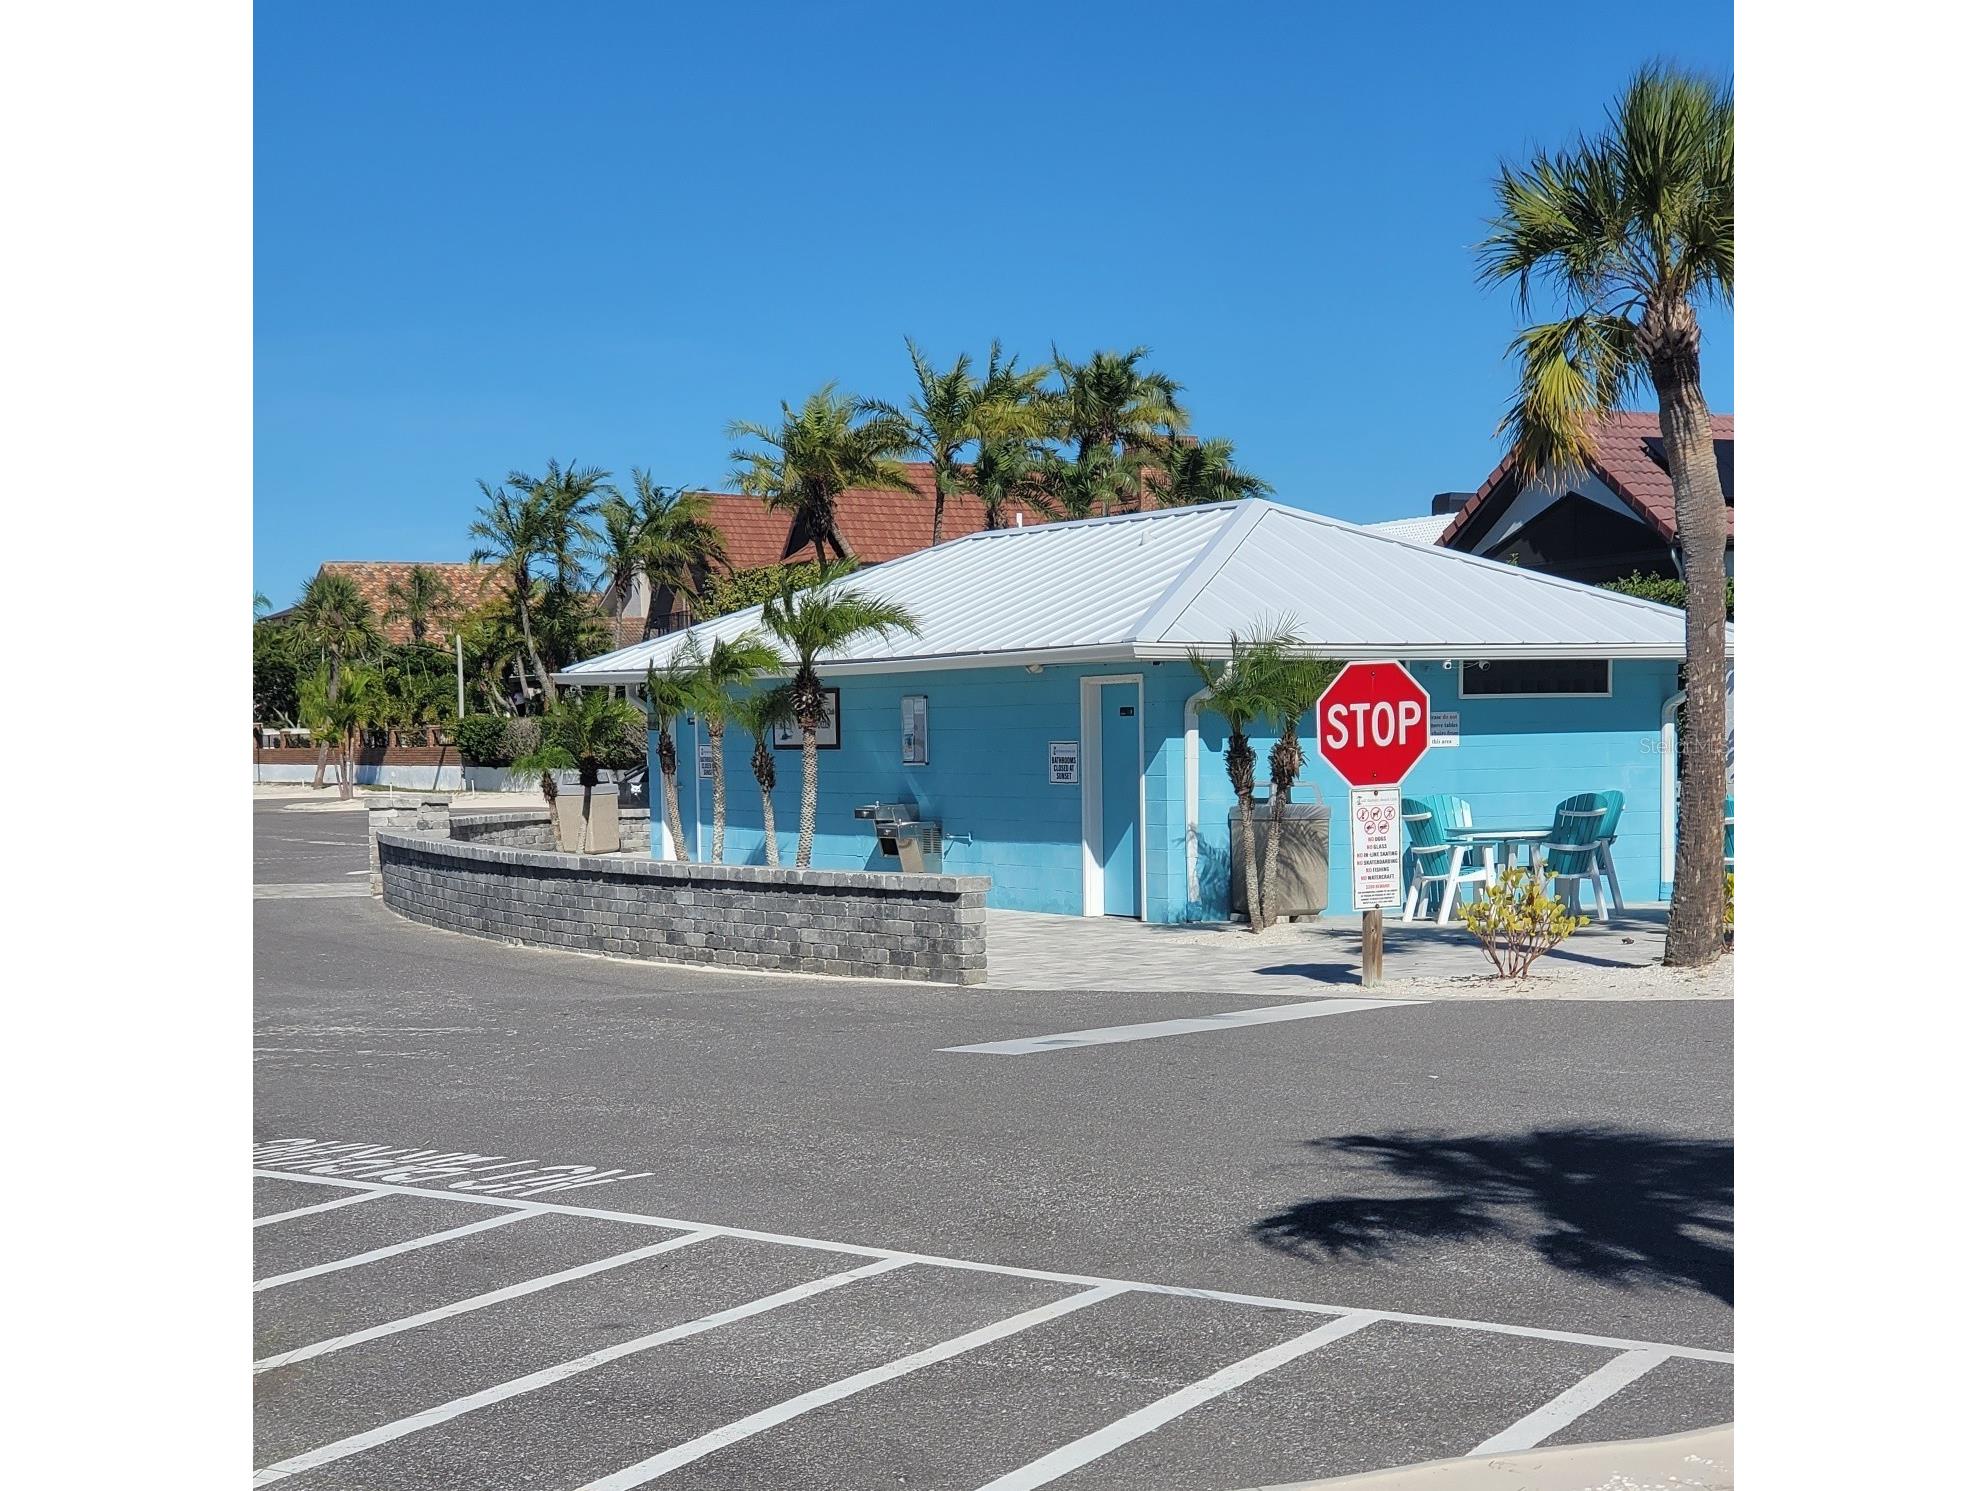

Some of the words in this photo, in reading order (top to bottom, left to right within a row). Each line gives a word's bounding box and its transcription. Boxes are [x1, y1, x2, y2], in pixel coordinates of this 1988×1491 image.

[1326, 701, 1422, 749] STOP
[1052, 756, 1076, 764] BATHROOMS
[1363, 858, 1398, 866] SKATEBOARDING
